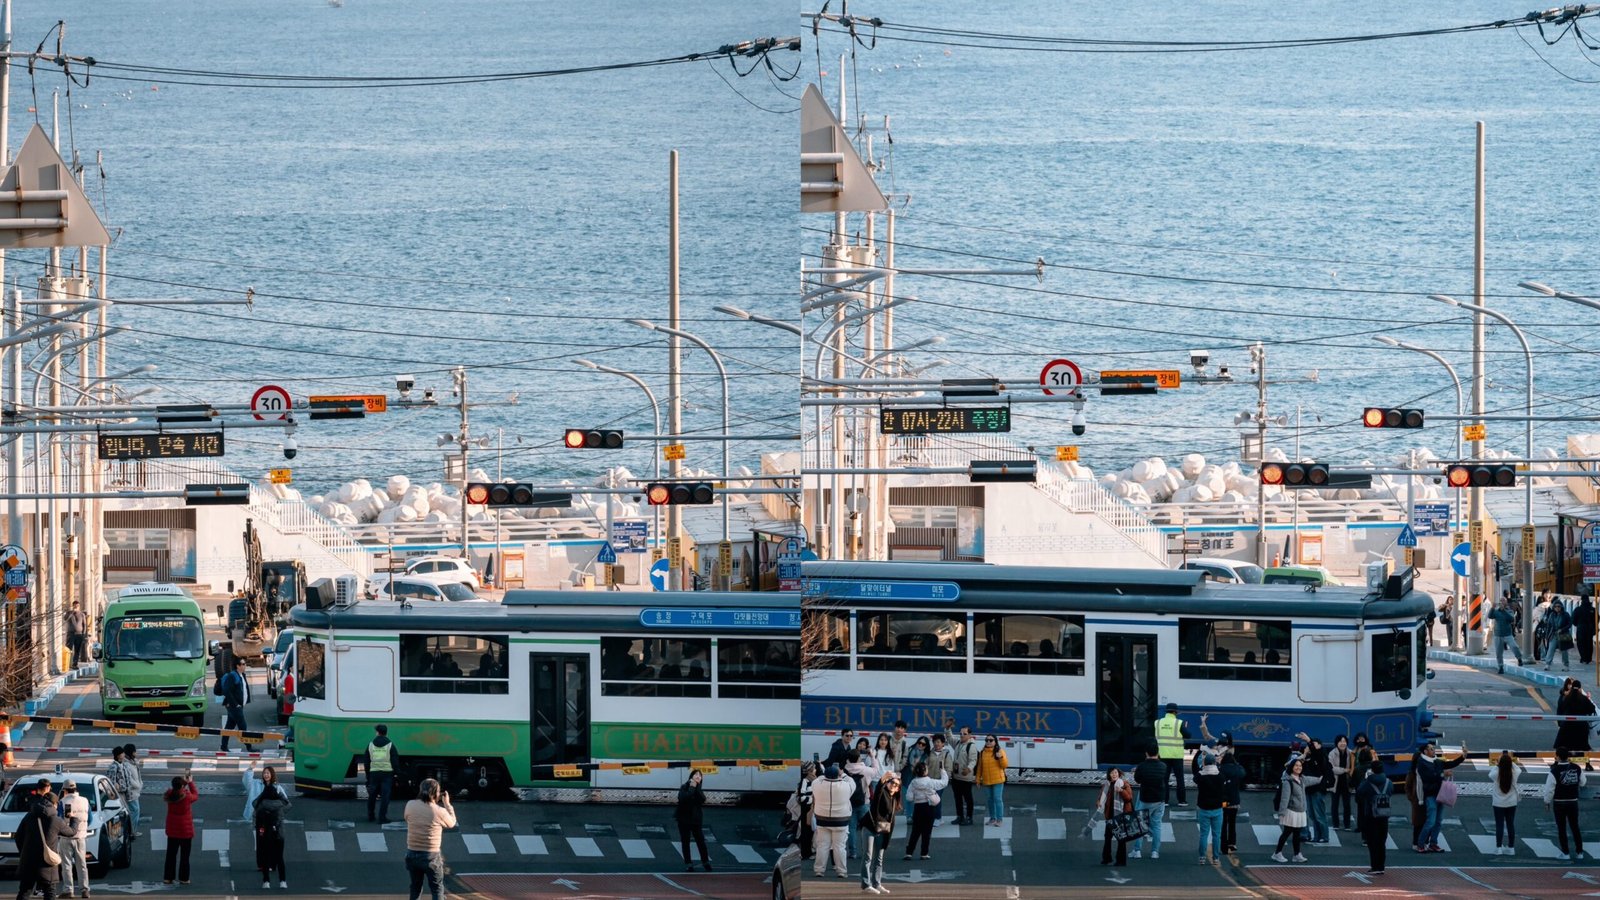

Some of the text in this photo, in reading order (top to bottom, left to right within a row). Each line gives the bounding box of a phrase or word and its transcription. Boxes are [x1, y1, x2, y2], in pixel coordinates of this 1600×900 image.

[159, 436, 186, 455] 단속
[193, 435, 219, 454] 시간
[824, 706, 956, 729] BLUELINE
[975, 710, 1052, 731] PARK
[632, 733, 785, 755] HAEUNDAE
